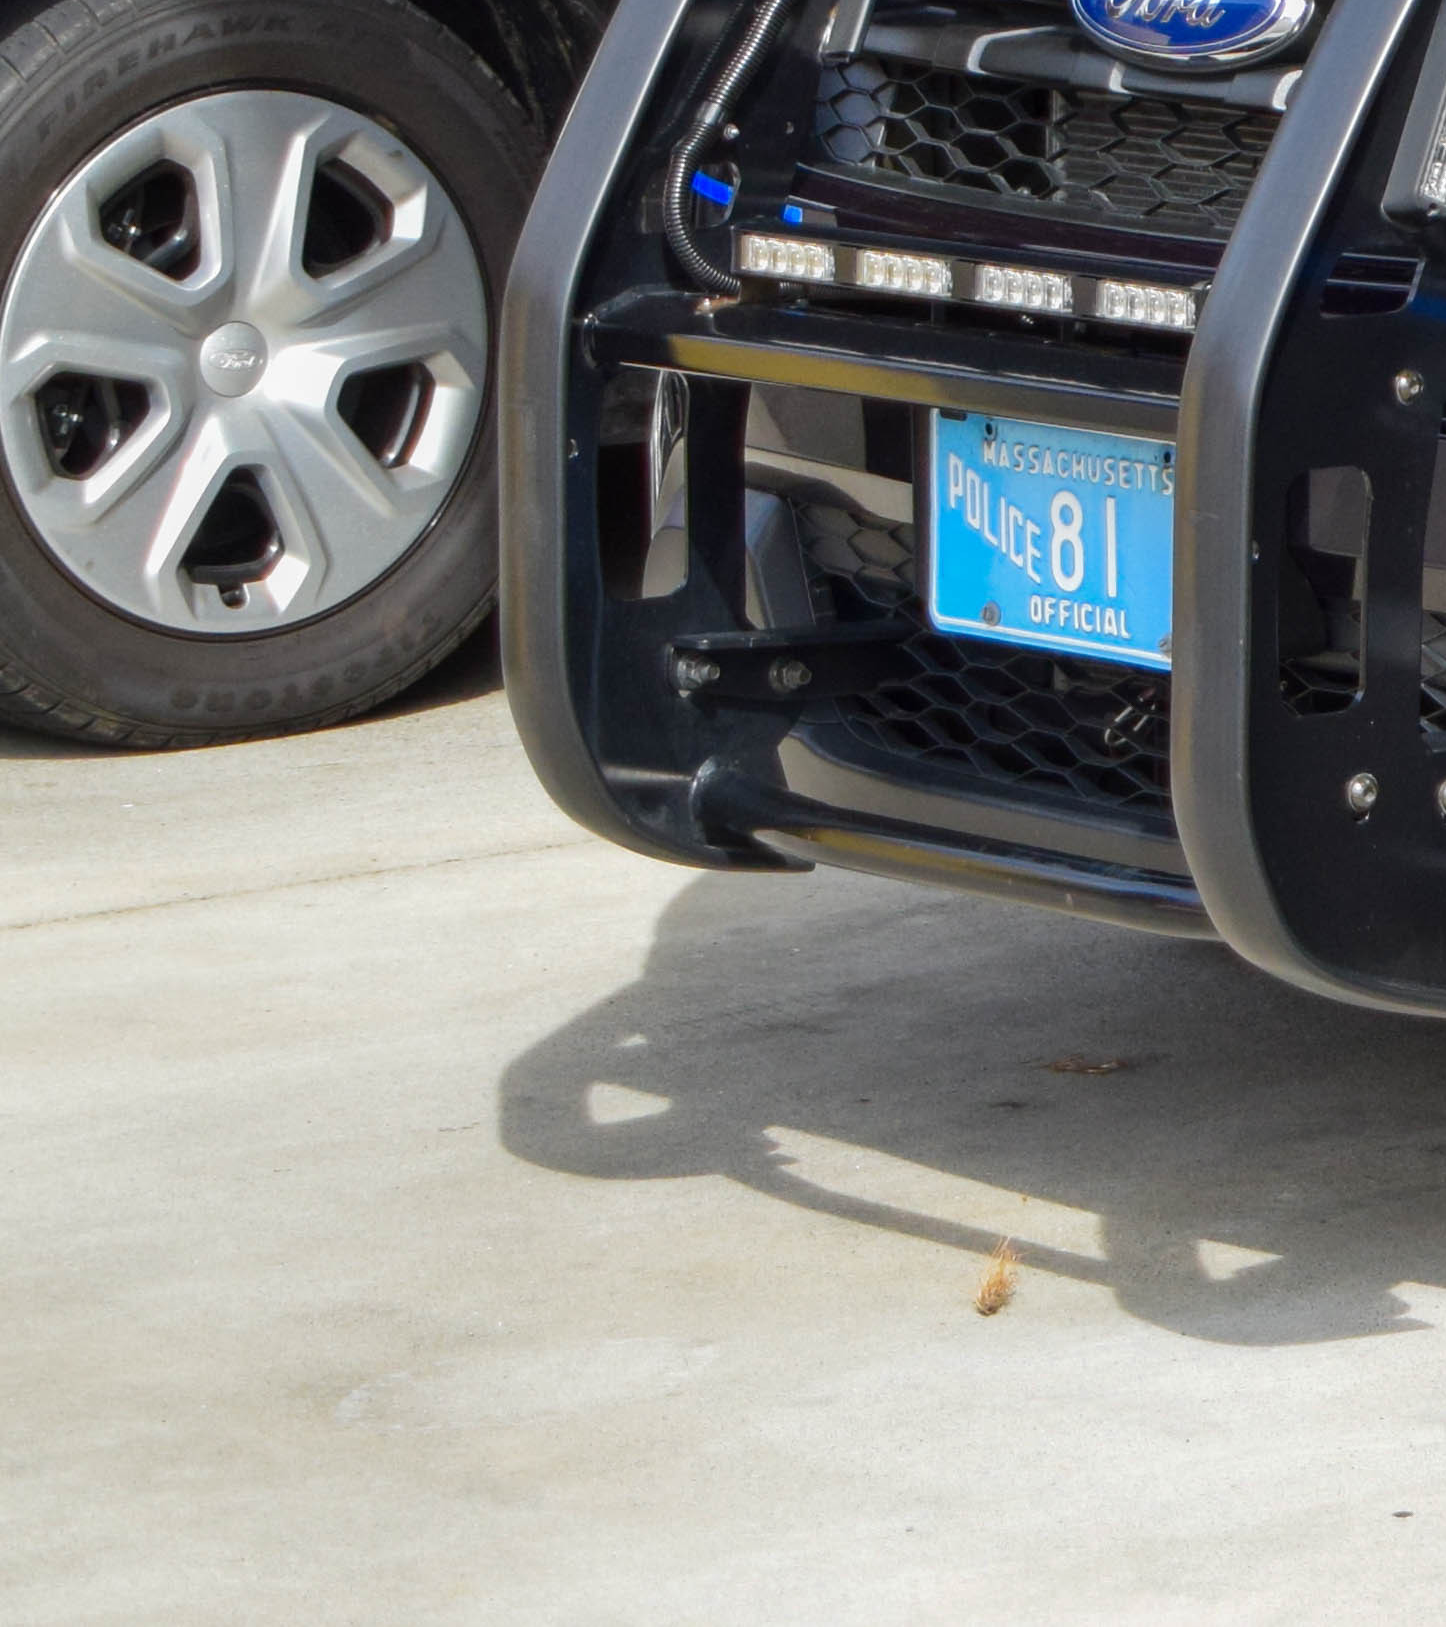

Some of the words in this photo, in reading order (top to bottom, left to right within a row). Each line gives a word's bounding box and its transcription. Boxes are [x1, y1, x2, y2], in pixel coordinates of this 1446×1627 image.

[983, 440, 1174, 496] MASSACHUSETTS
[950, 452, 1041, 584] POLICE
[1050, 490, 1118, 598] 81
[1029, 594, 1131, 639] OFFICIAL
